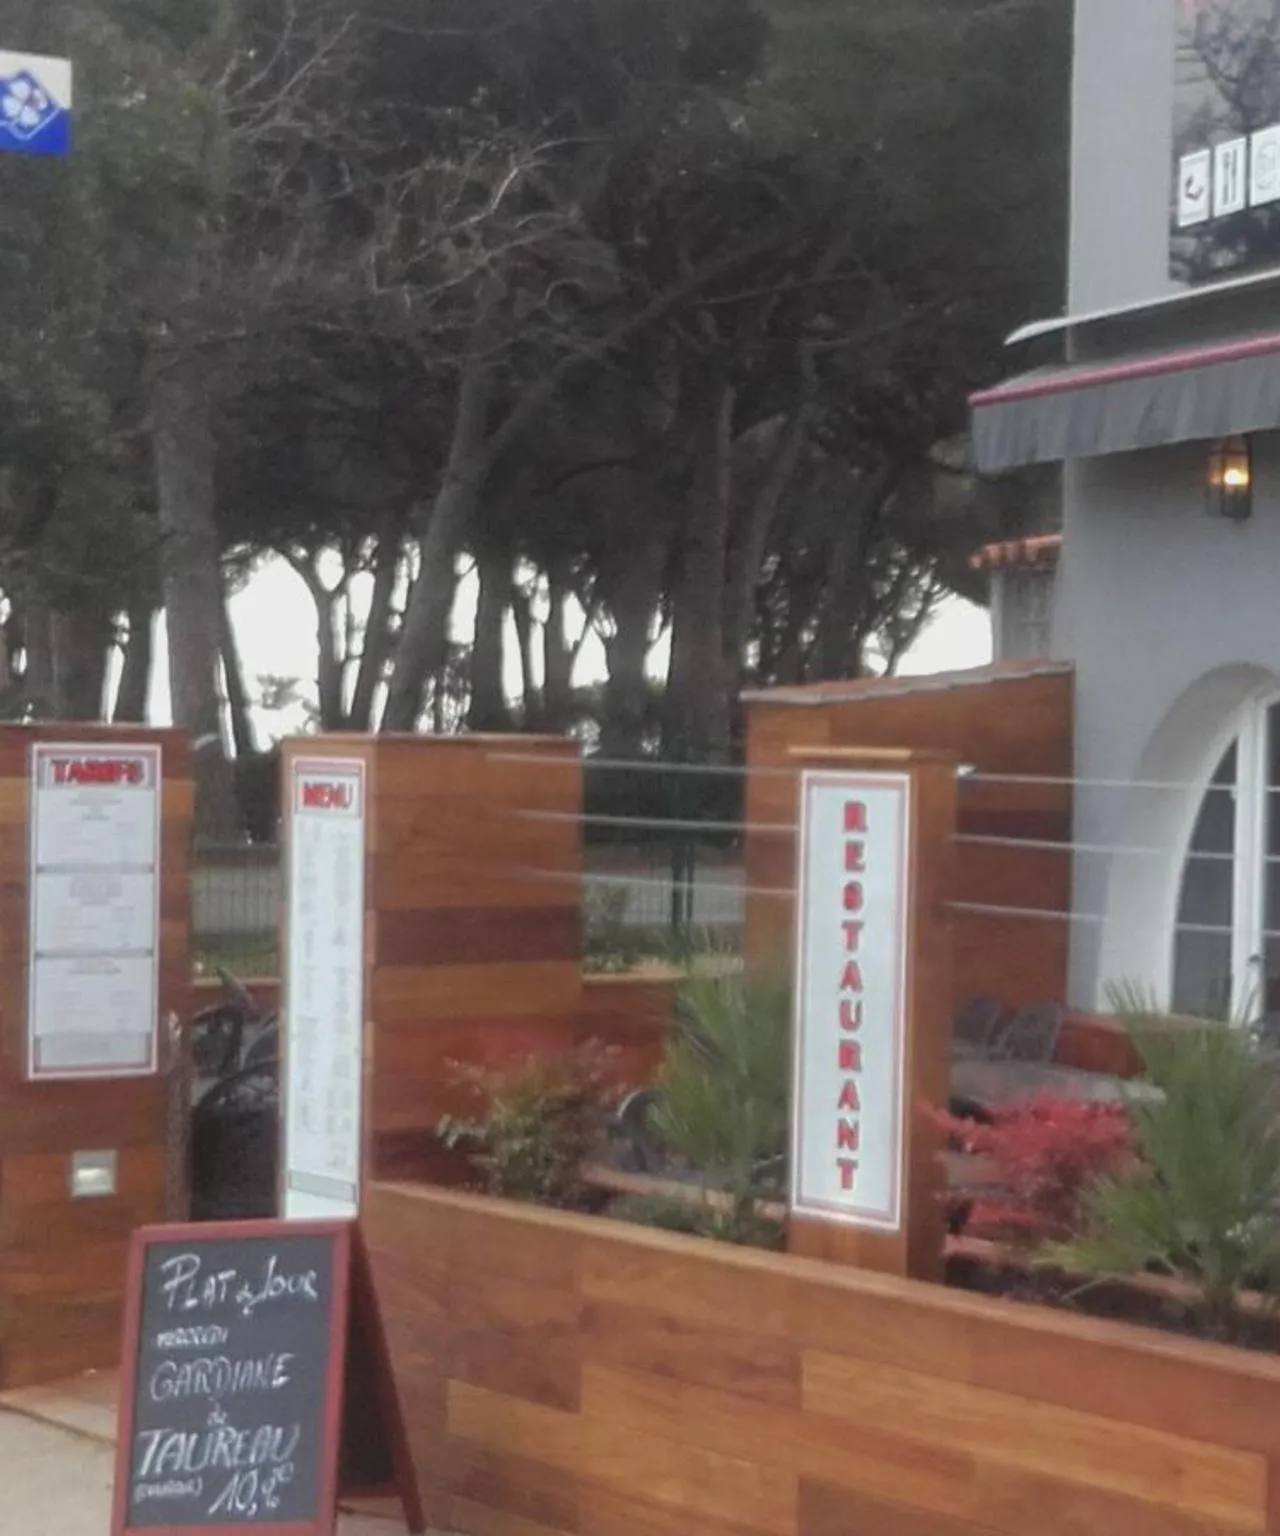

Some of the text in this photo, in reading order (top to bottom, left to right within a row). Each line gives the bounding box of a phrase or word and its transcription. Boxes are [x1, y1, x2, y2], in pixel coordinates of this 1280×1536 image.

[301, 781, 354, 809] MENU
[835, 800, 869, 1191] RESTAURANT
[139, 1421, 301, 1477] TAUREAU
